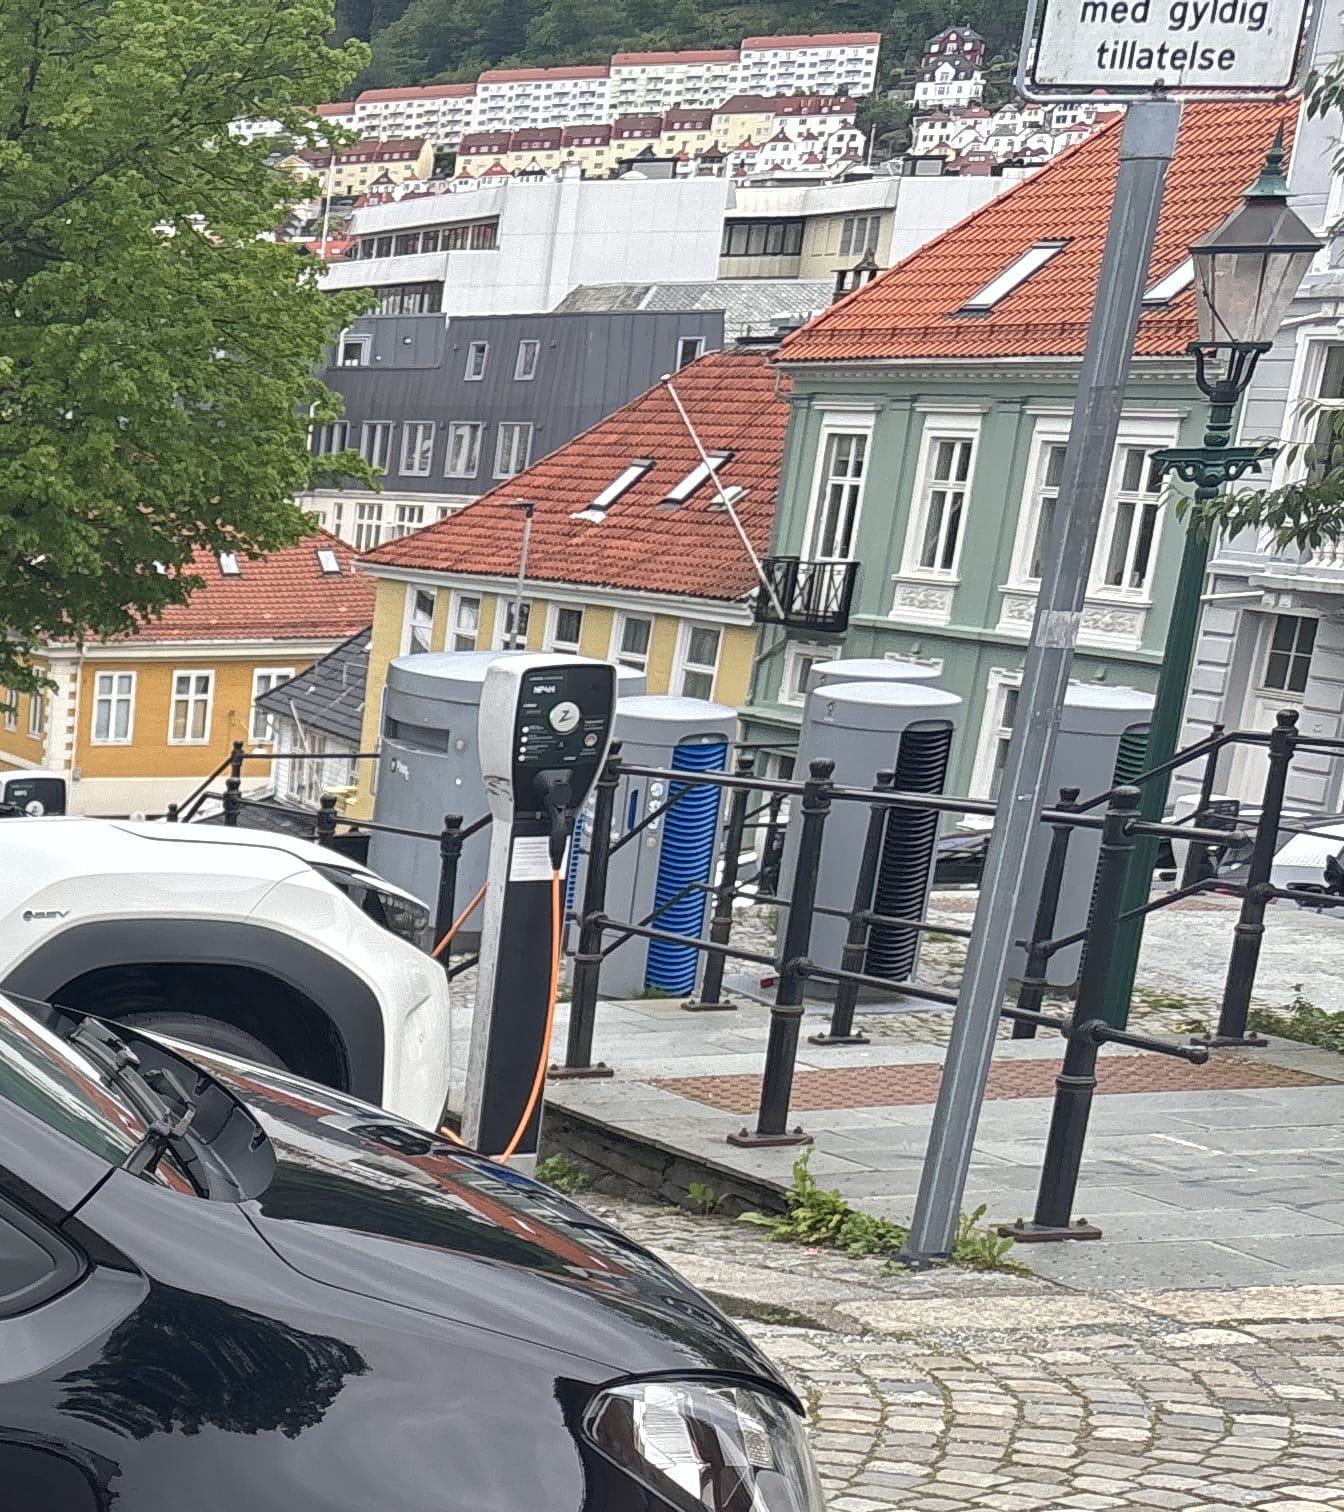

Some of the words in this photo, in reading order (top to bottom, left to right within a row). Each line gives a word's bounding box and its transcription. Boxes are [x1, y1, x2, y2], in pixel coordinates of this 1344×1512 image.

[1080, 0, 1150, 24] med
[1168, 0, 1269, 31] gyldig
[1096, 40, 1236, 70] tillatelse
